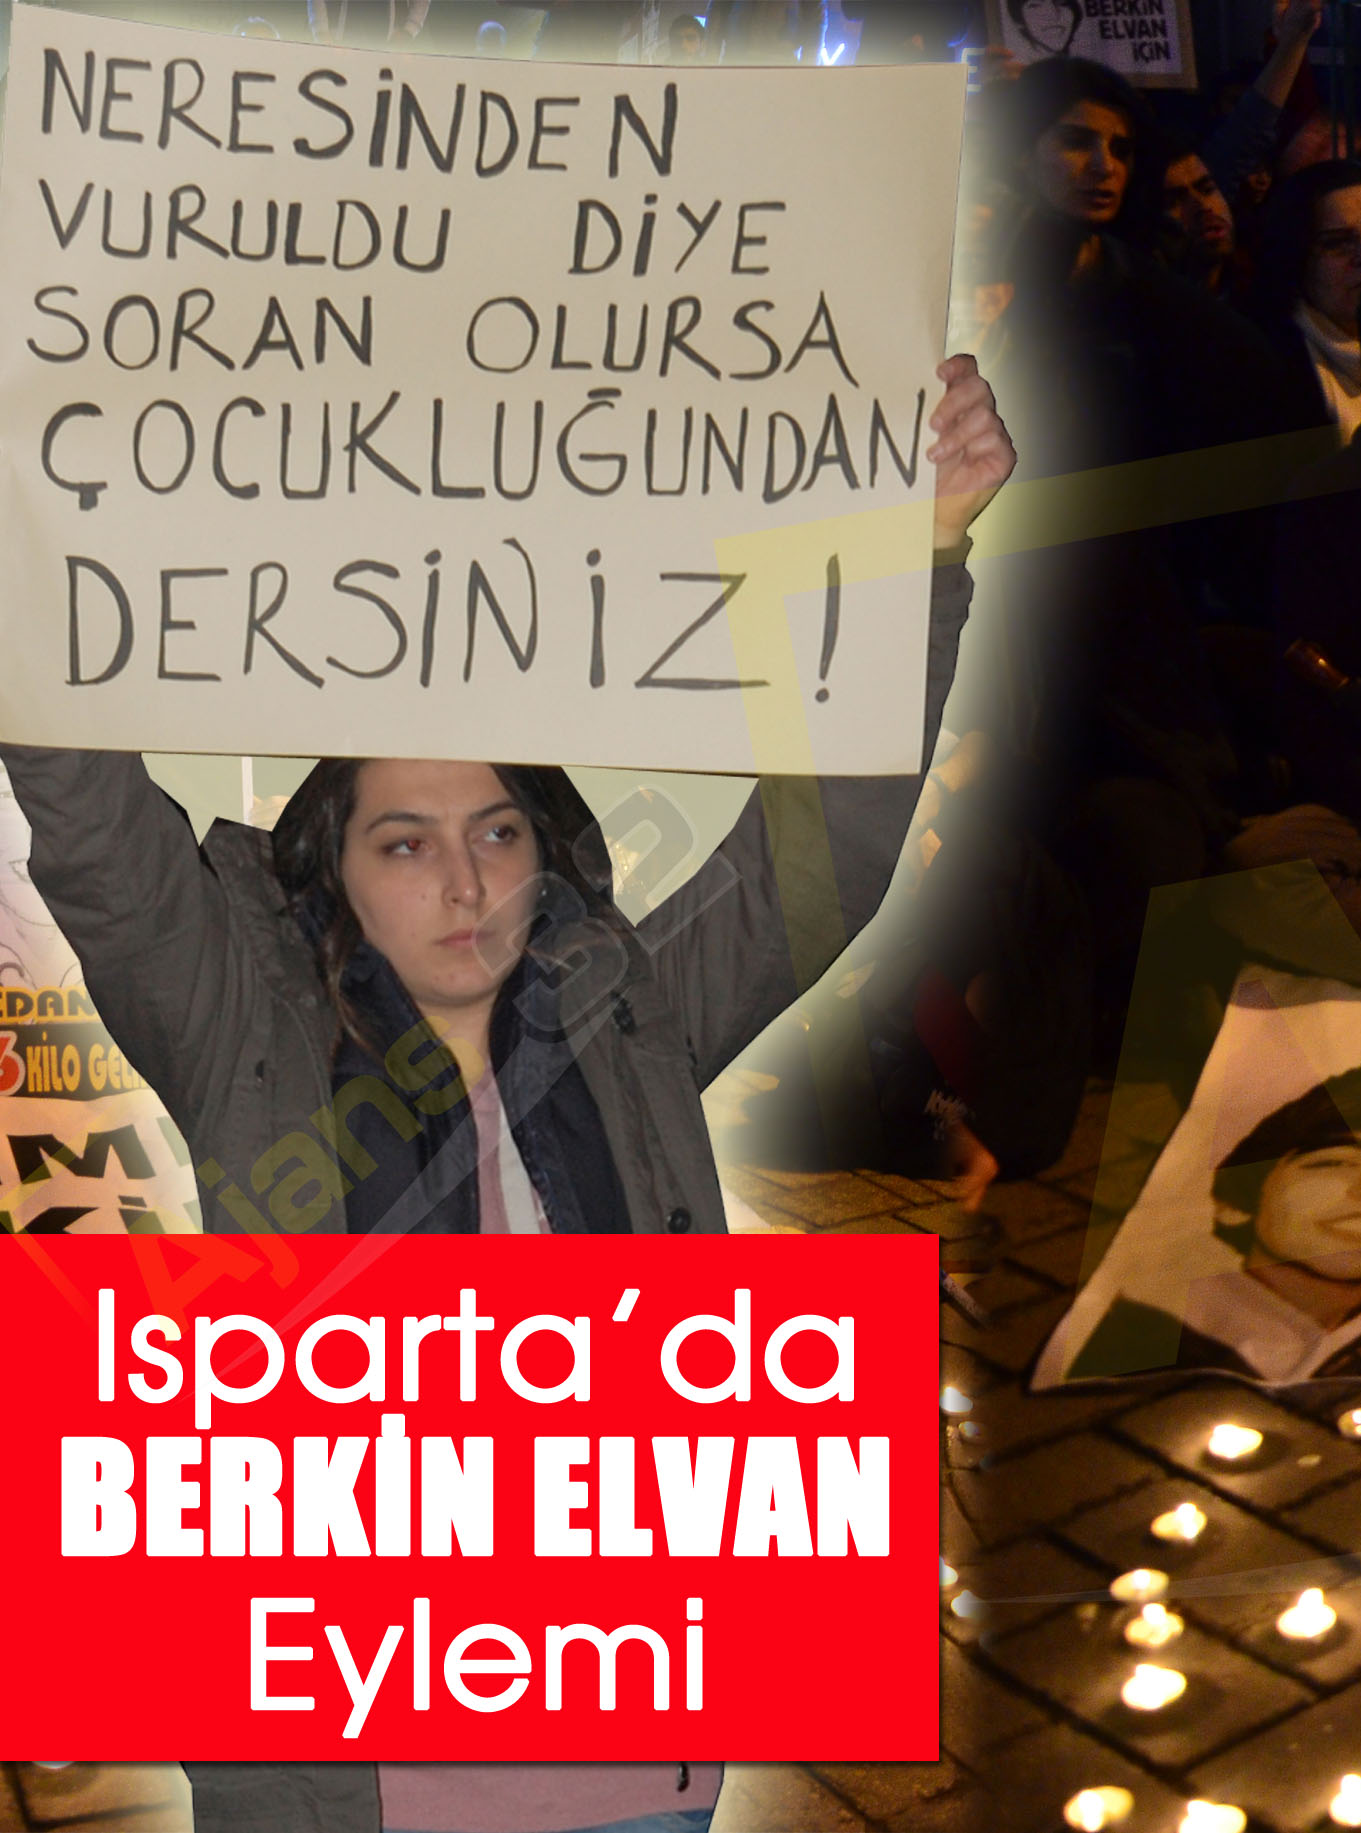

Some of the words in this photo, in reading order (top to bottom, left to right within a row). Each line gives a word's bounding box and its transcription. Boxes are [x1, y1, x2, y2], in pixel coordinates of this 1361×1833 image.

[1099, 19, 1167, 39] ELVAN
[38, 179, 452, 272] VURULDU
[26, 285, 374, 371] SORAN
[465, 290, 860, 387] OLURSA
[39, 387, 928, 511] ÇOCUKLUĞUNDAN
